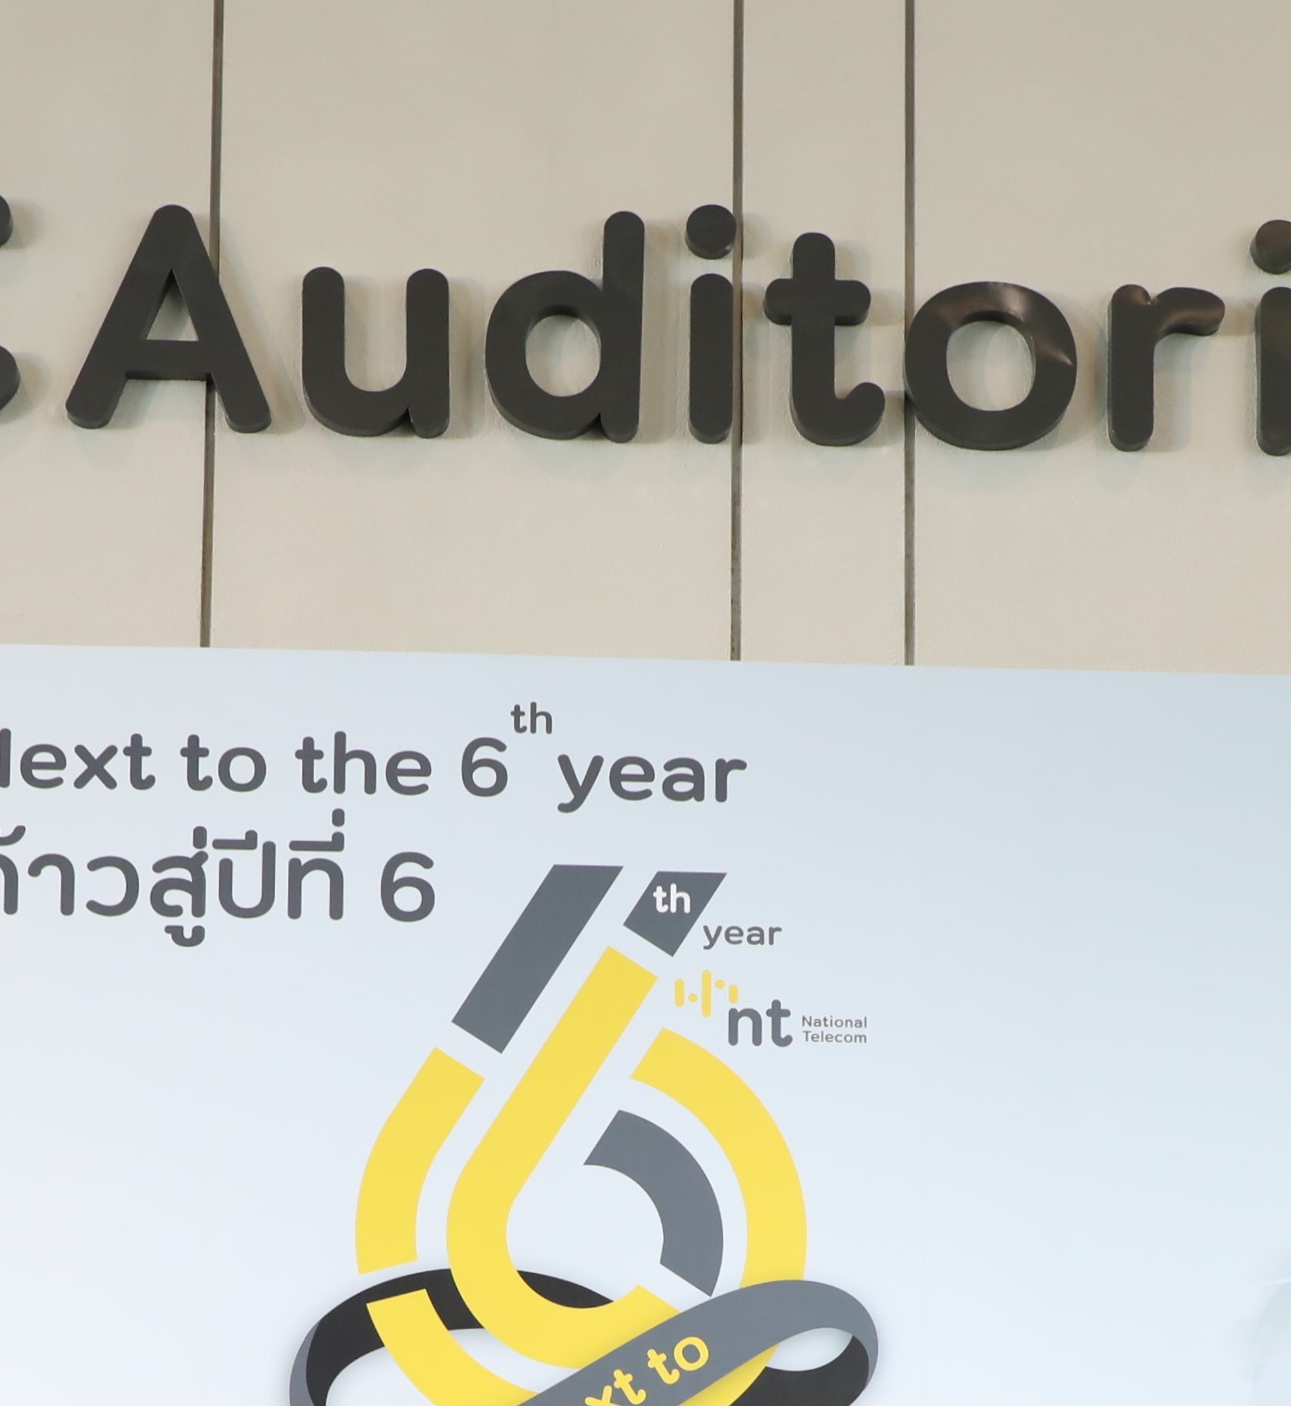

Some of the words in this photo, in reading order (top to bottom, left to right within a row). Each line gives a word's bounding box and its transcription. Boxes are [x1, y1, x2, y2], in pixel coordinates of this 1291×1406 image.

[179, 733, 268, 793] to
[295, 731, 433, 796] the
[557, 754, 748, 814] year
[380, 851, 437, 923] 6
[653, 883, 691, 914] th
[702, 925, 783, 951] year
[728, 999, 793, 1048] nt
[801, 1015, 868, 1029] National
[802, 1030, 868, 1044] Telecom
[647, 1335, 710, 1385] to
